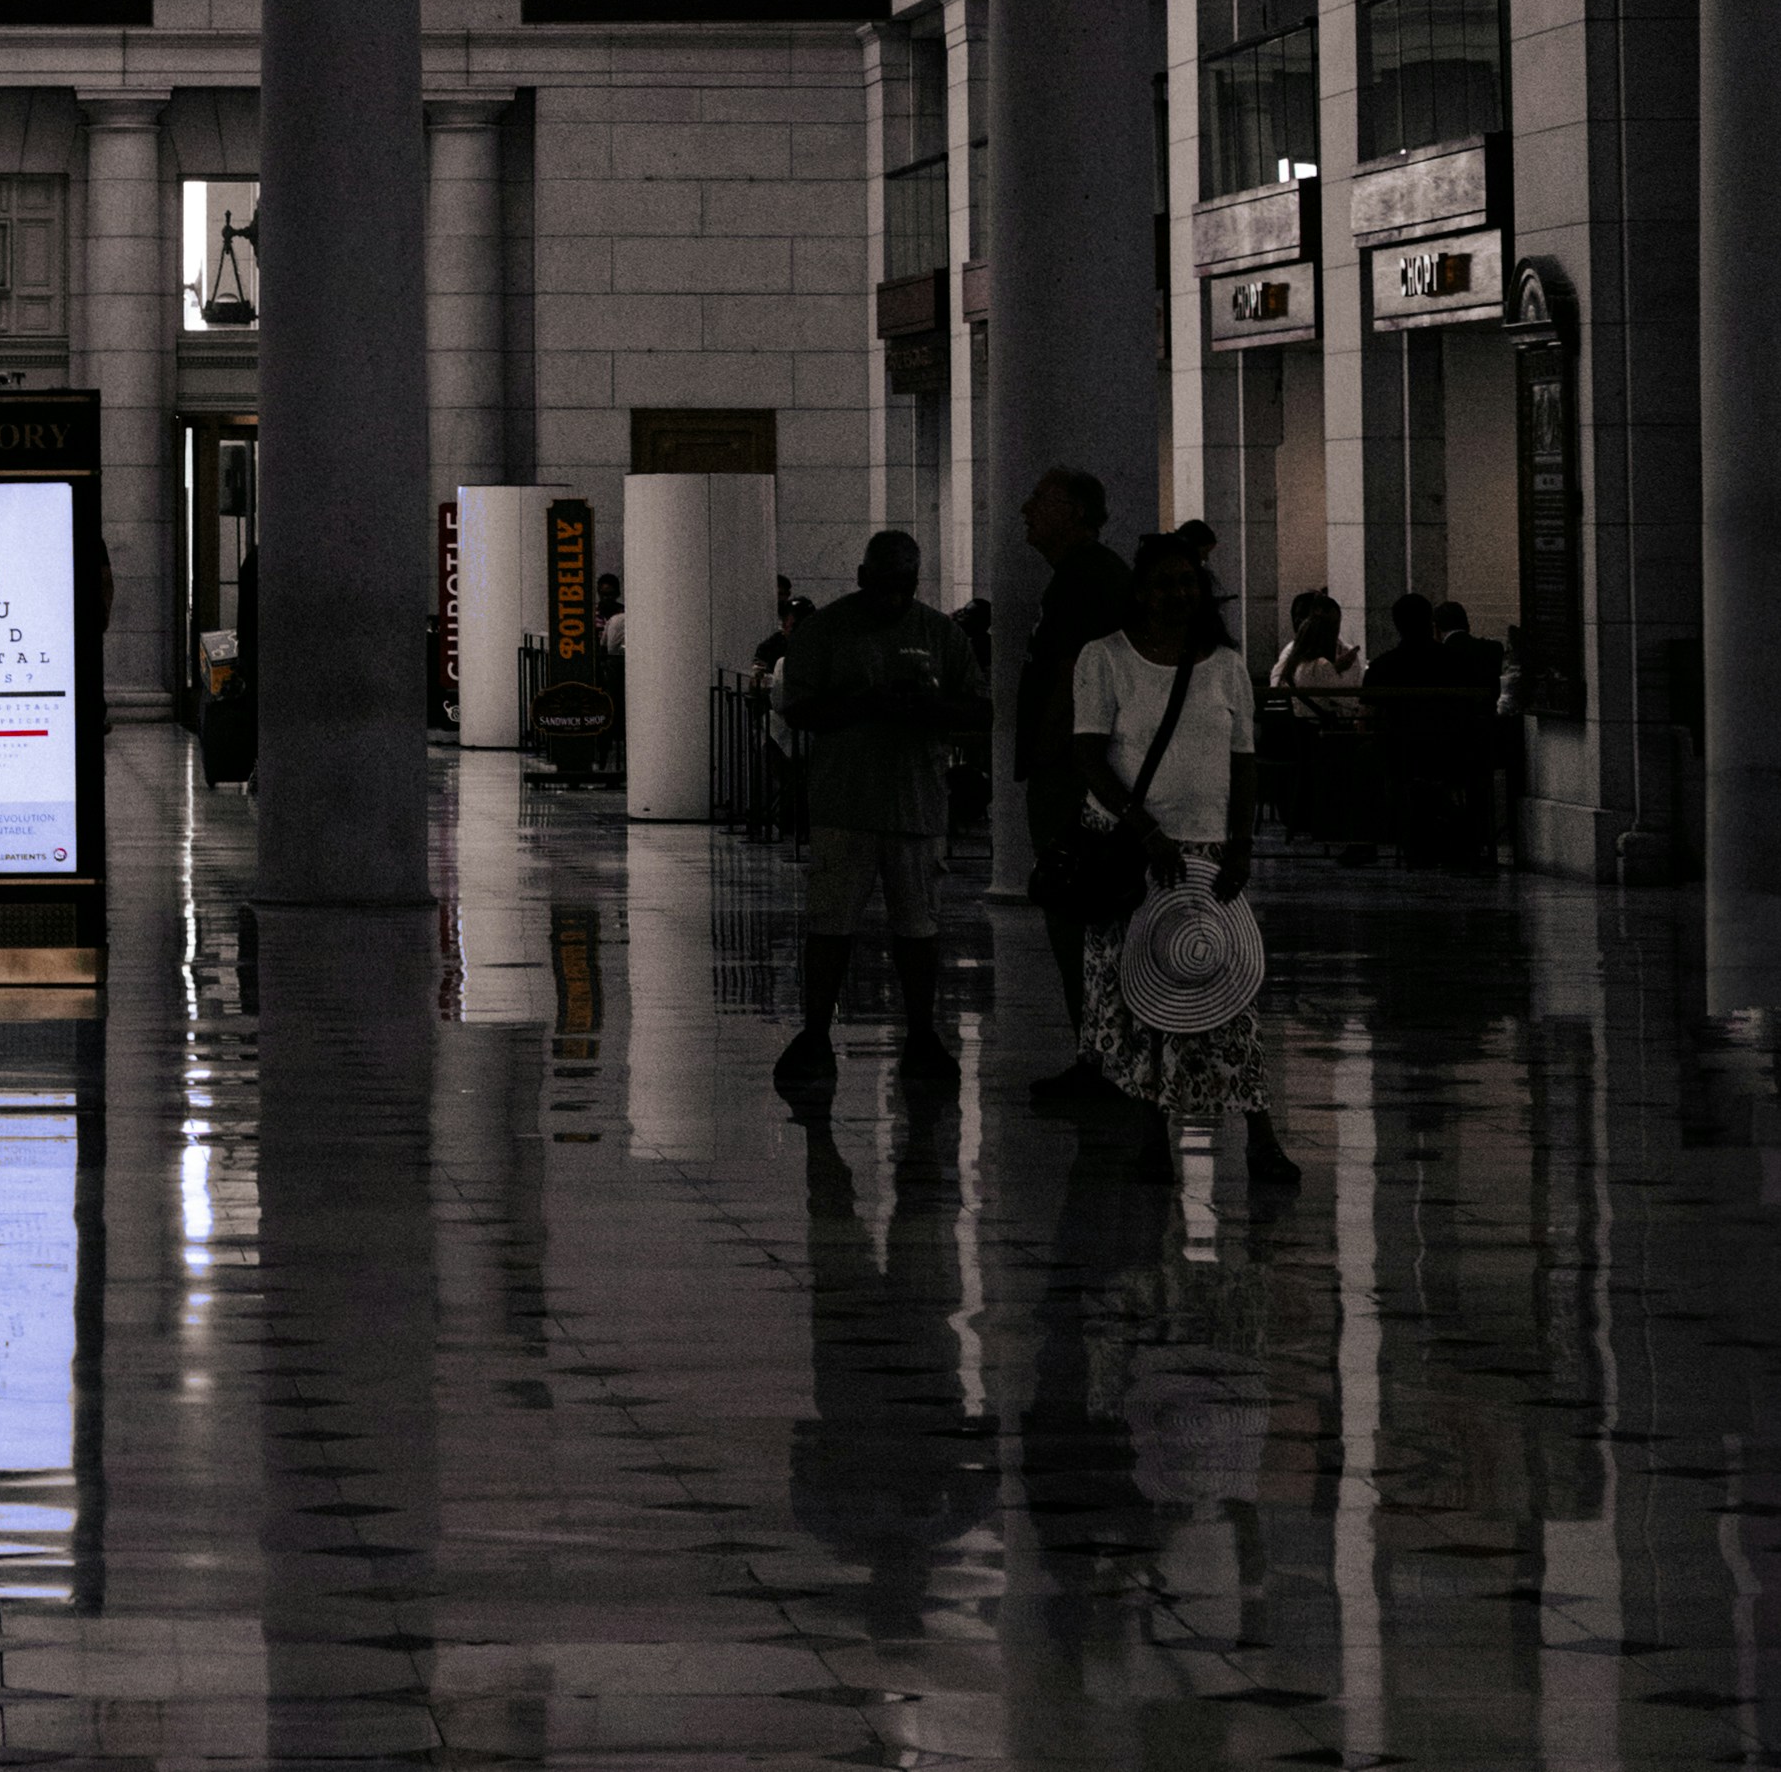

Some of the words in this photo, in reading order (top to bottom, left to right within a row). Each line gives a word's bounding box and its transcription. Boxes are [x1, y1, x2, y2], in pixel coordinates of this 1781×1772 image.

[1399, 253, 1440, 297] CHOPT
[556, 518, 585, 660] POTBELLY
[0, 716, 50, 725] PRICES
[539, 715, 581, 727] SANDWICH
[584, 714, 606, 726] SHOP
